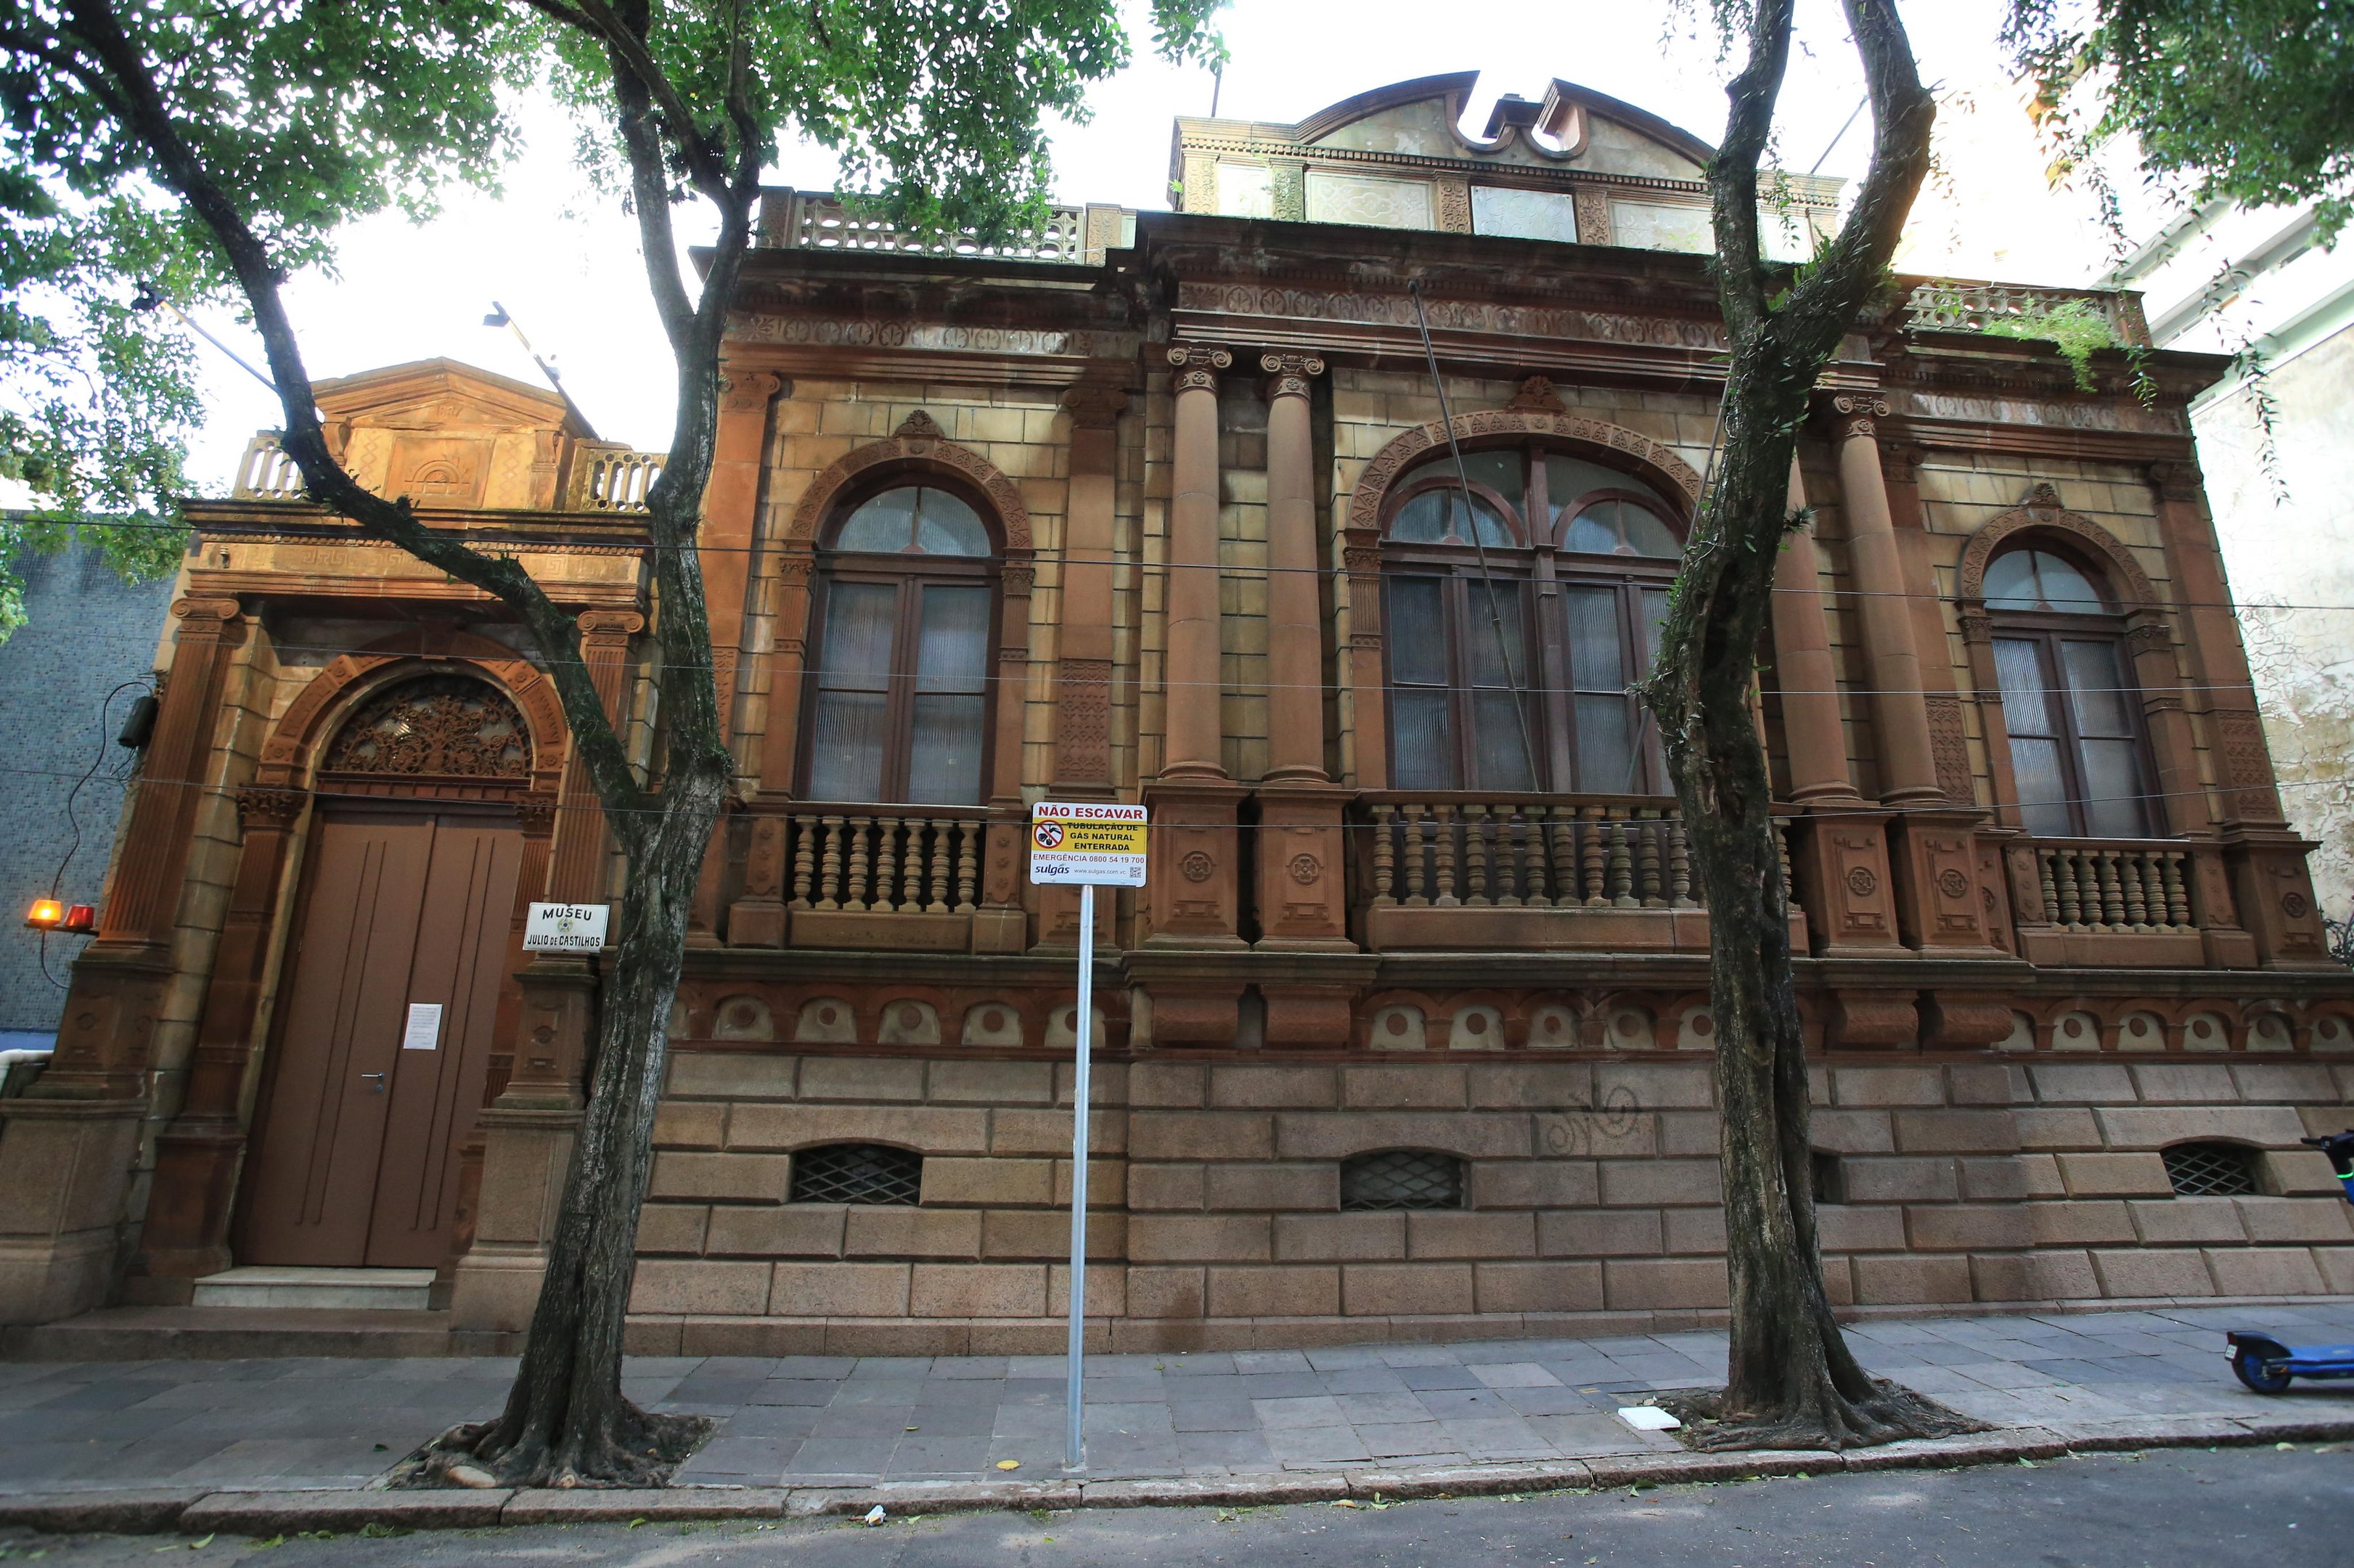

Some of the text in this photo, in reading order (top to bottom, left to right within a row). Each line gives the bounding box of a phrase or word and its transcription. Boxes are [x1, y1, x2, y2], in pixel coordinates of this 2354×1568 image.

[1039, 805, 1143, 820] NÃO ESCAVAR
[1067, 822, 1124, 831] TUBULAÇÃO
[1074, 842, 1129, 851] ENTERRADA
[1033, 853, 1087, 862] EMERGÊNCIA
[1035, 864, 1070, 875] sulgás
[543, 908, 592, 920] MUSEU
[528, 935, 548, 944] JULIO
[560, 936, 600, 947] CASTILHOS
